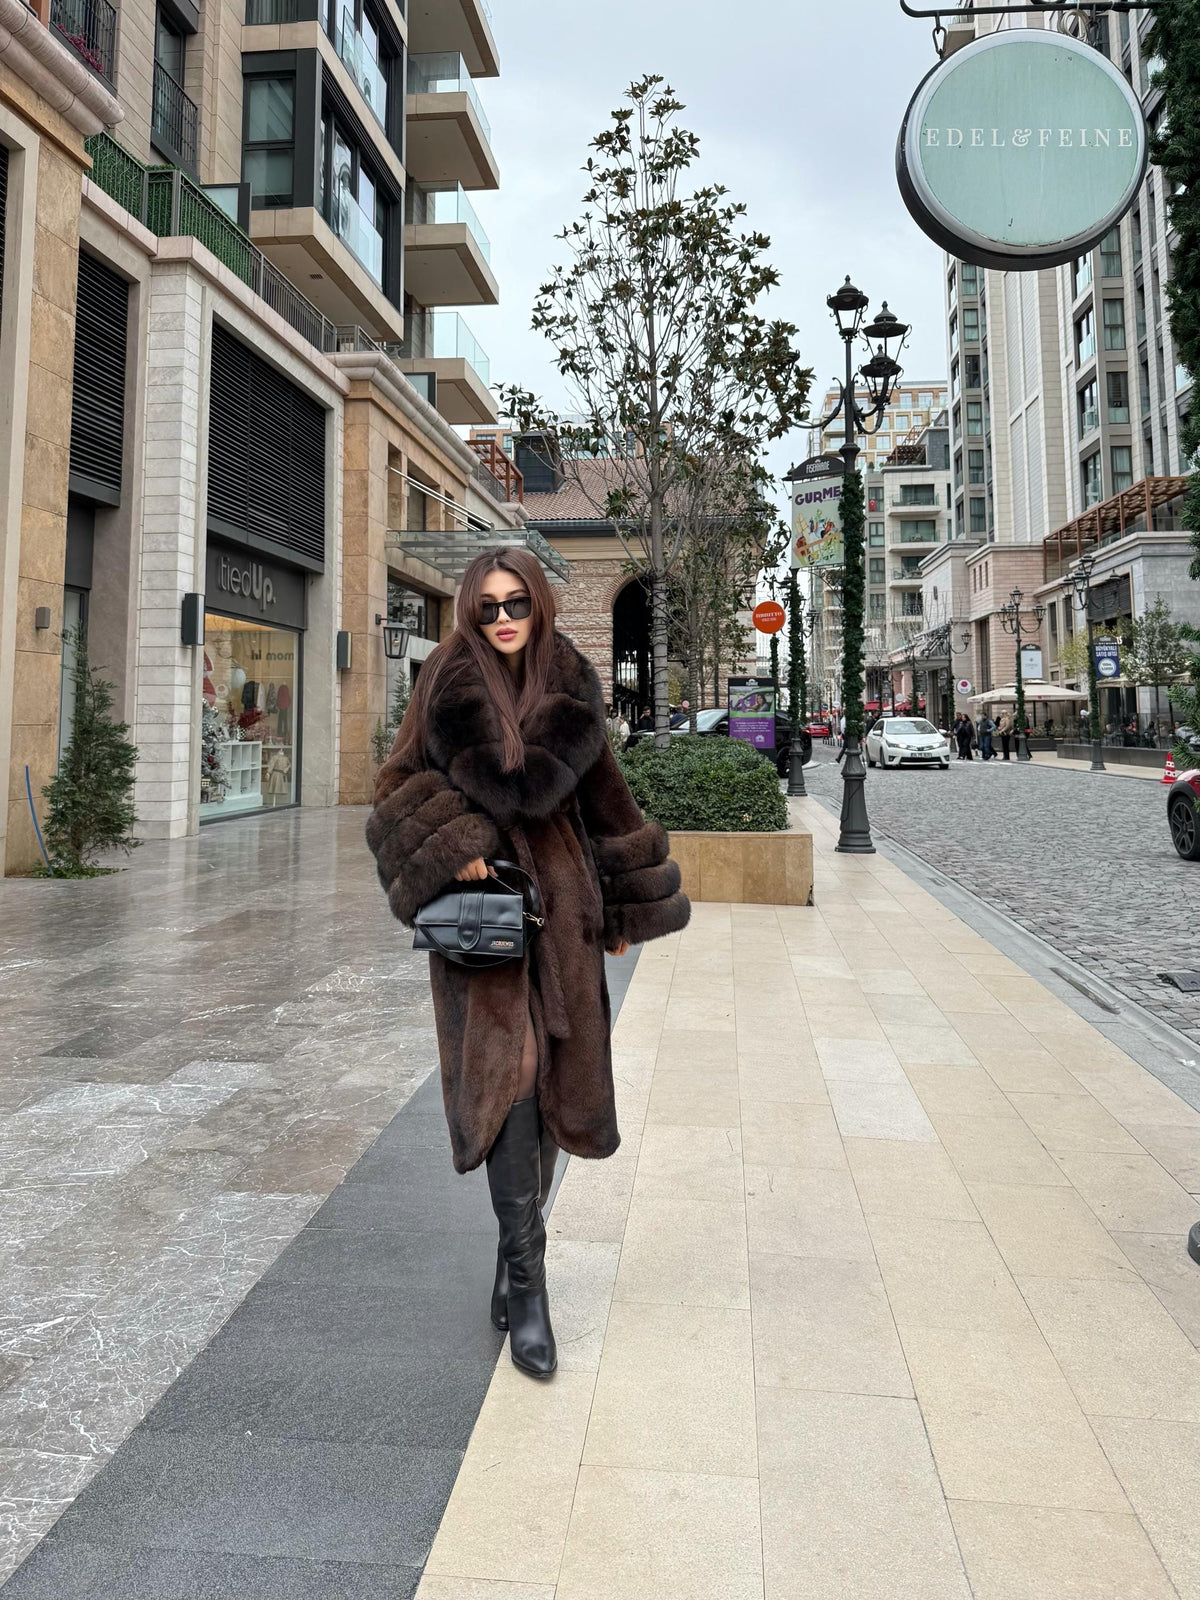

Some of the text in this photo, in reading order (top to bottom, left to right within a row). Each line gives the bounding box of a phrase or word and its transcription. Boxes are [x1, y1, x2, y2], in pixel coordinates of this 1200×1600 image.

[925, 128, 1133, 148] EDEL&FEINE
[795, 486, 841, 505] GURME
[218, 556, 276, 610] tiedUp.
